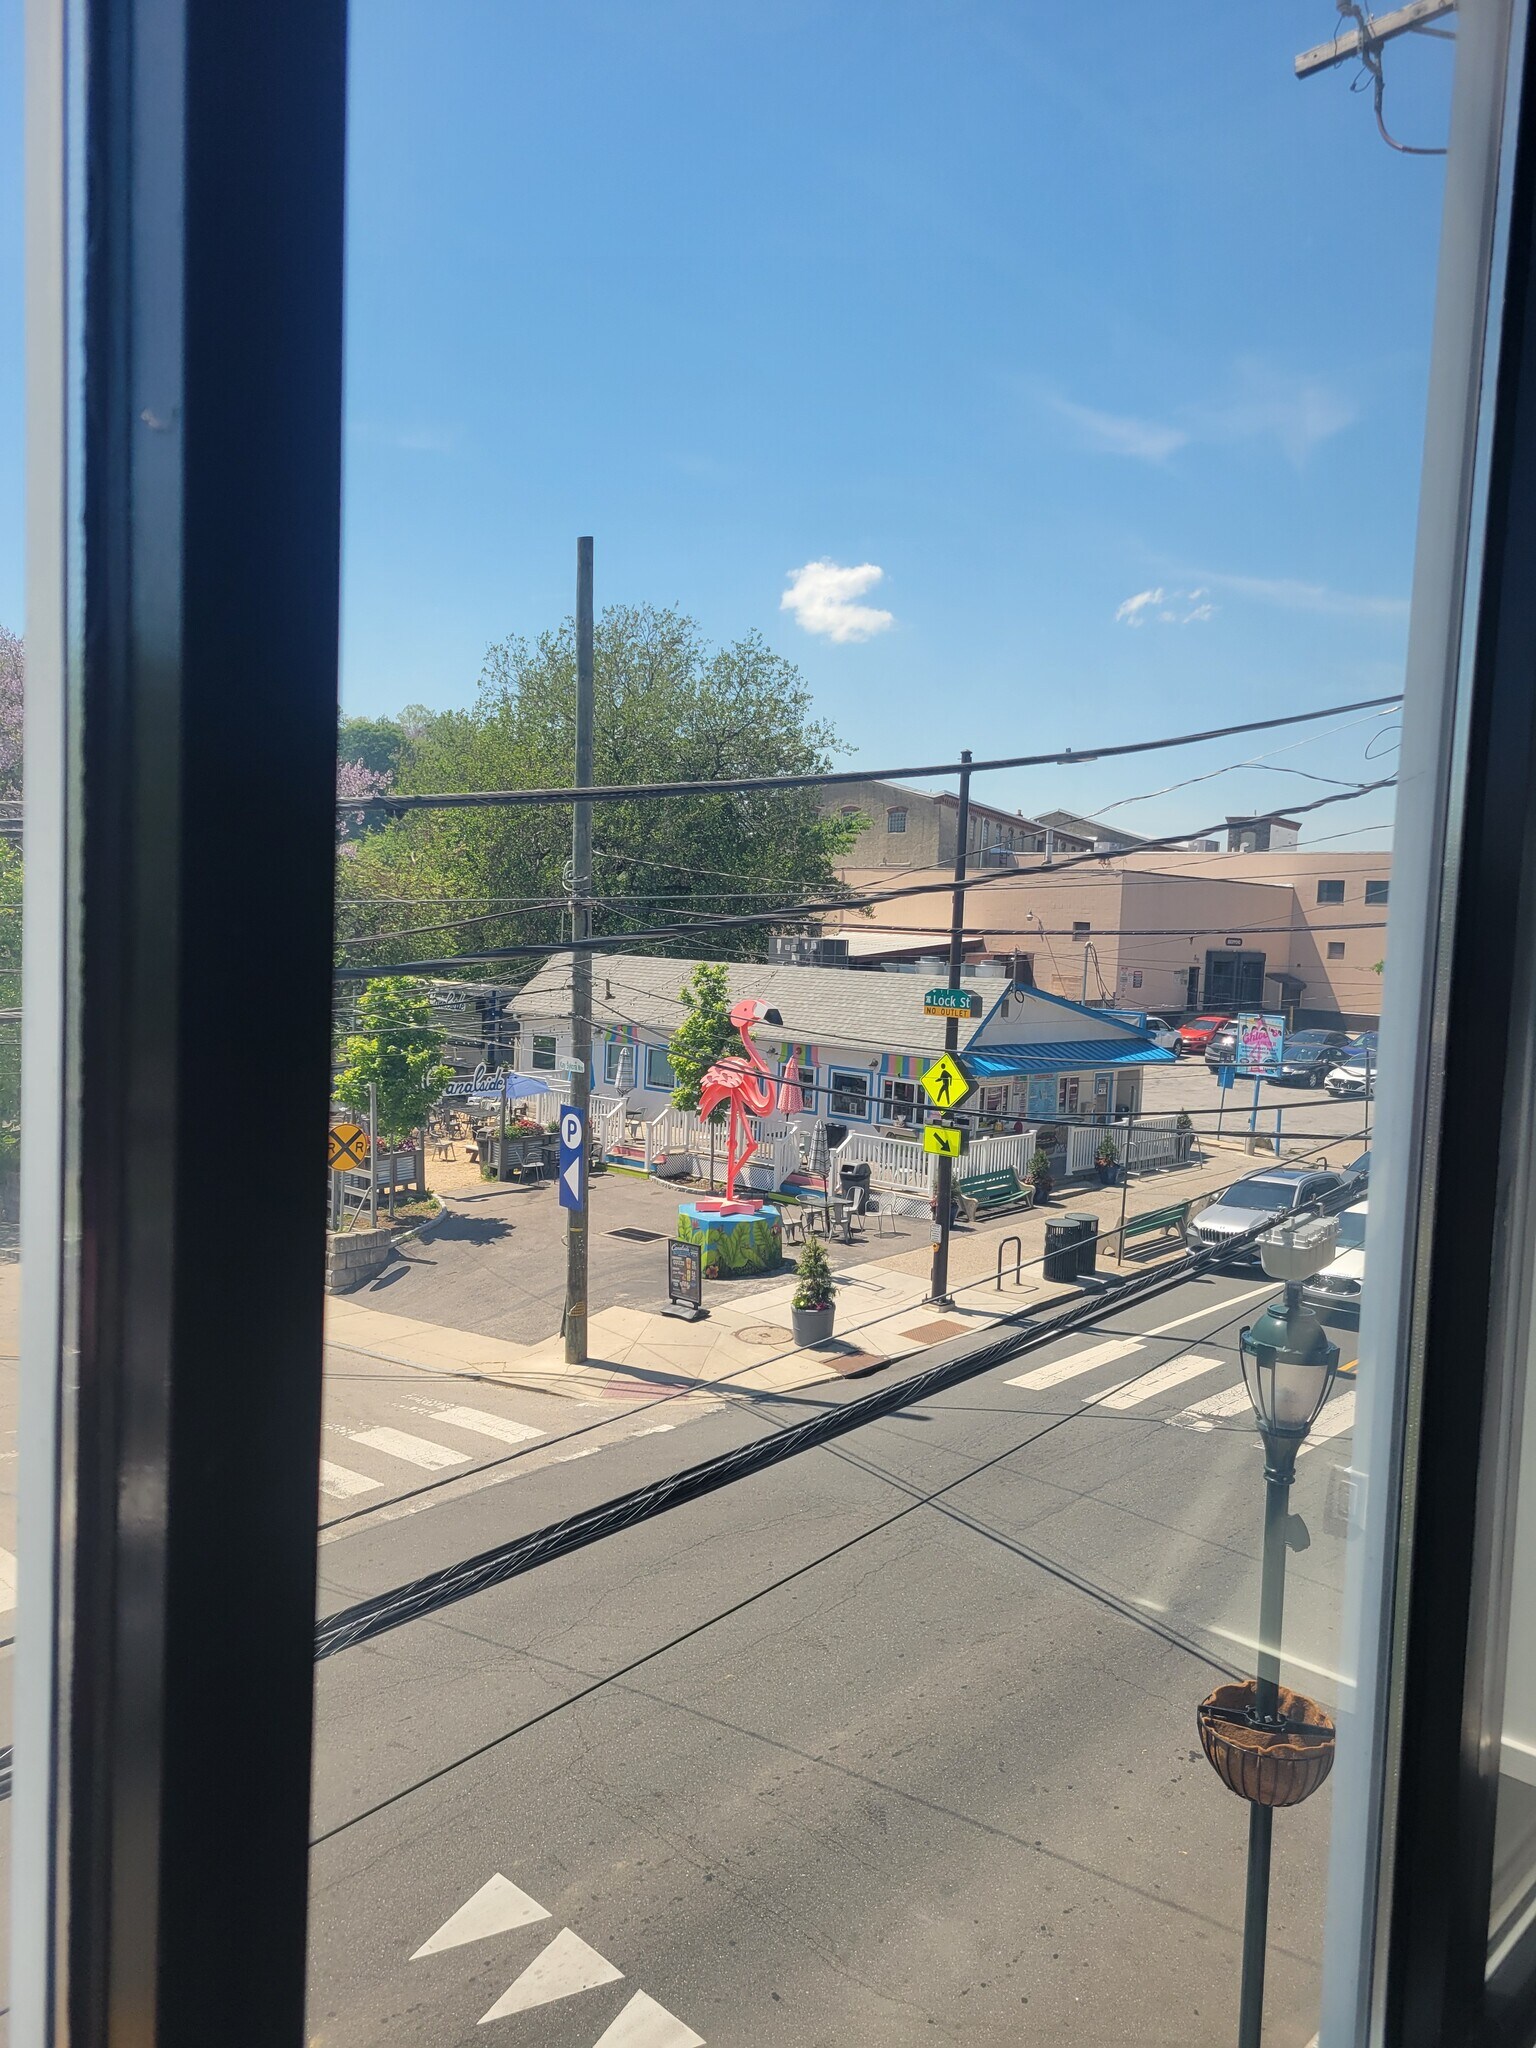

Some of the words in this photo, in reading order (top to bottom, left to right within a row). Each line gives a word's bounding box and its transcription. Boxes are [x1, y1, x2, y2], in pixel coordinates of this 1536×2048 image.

[933, 995, 956, 1007] Lock
[960, 997, 971, 1009] St
[926, 1007, 937, 1015] NO
[940, 1008, 968, 1018] OUTLET
[567, 1119, 578, 1143] P
[355, 1141, 364, 1153] R
